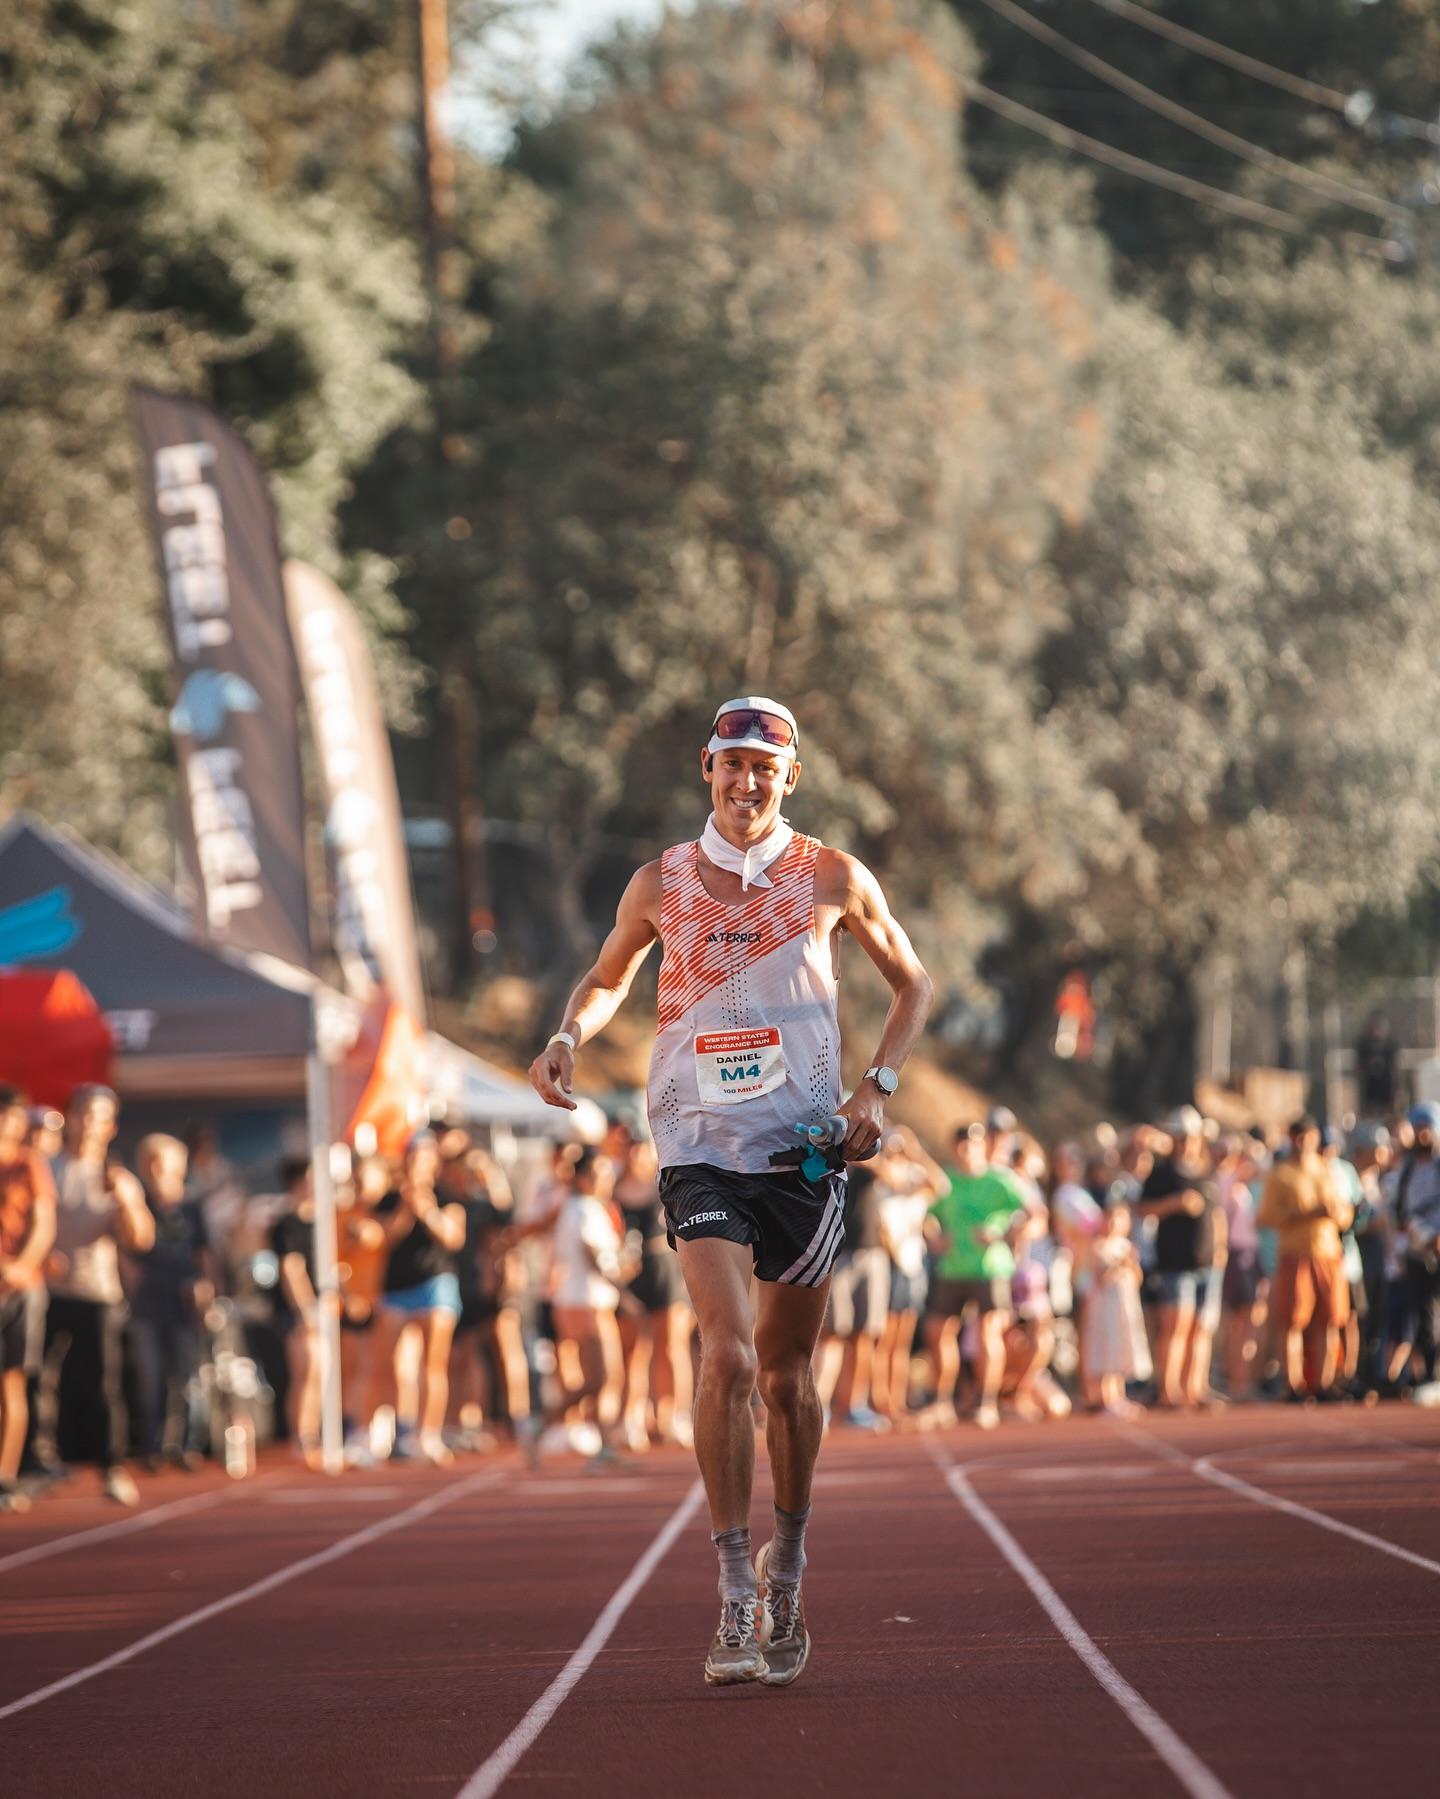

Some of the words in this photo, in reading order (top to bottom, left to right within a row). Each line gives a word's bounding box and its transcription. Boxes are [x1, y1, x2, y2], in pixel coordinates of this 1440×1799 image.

[719, 932, 762, 943] TERREX
[704, 1035, 740, 1043] WESTERN
[741, 1032, 769, 1040] STATES
[704, 1041, 752, 1050] ENDURANCE
[716, 1053, 762, 1064] DANIEL
[720, 1064, 761, 1082] M4
[737, 1083, 763, 1093] MILES
[688, 1210, 729, 1226] TERREX
